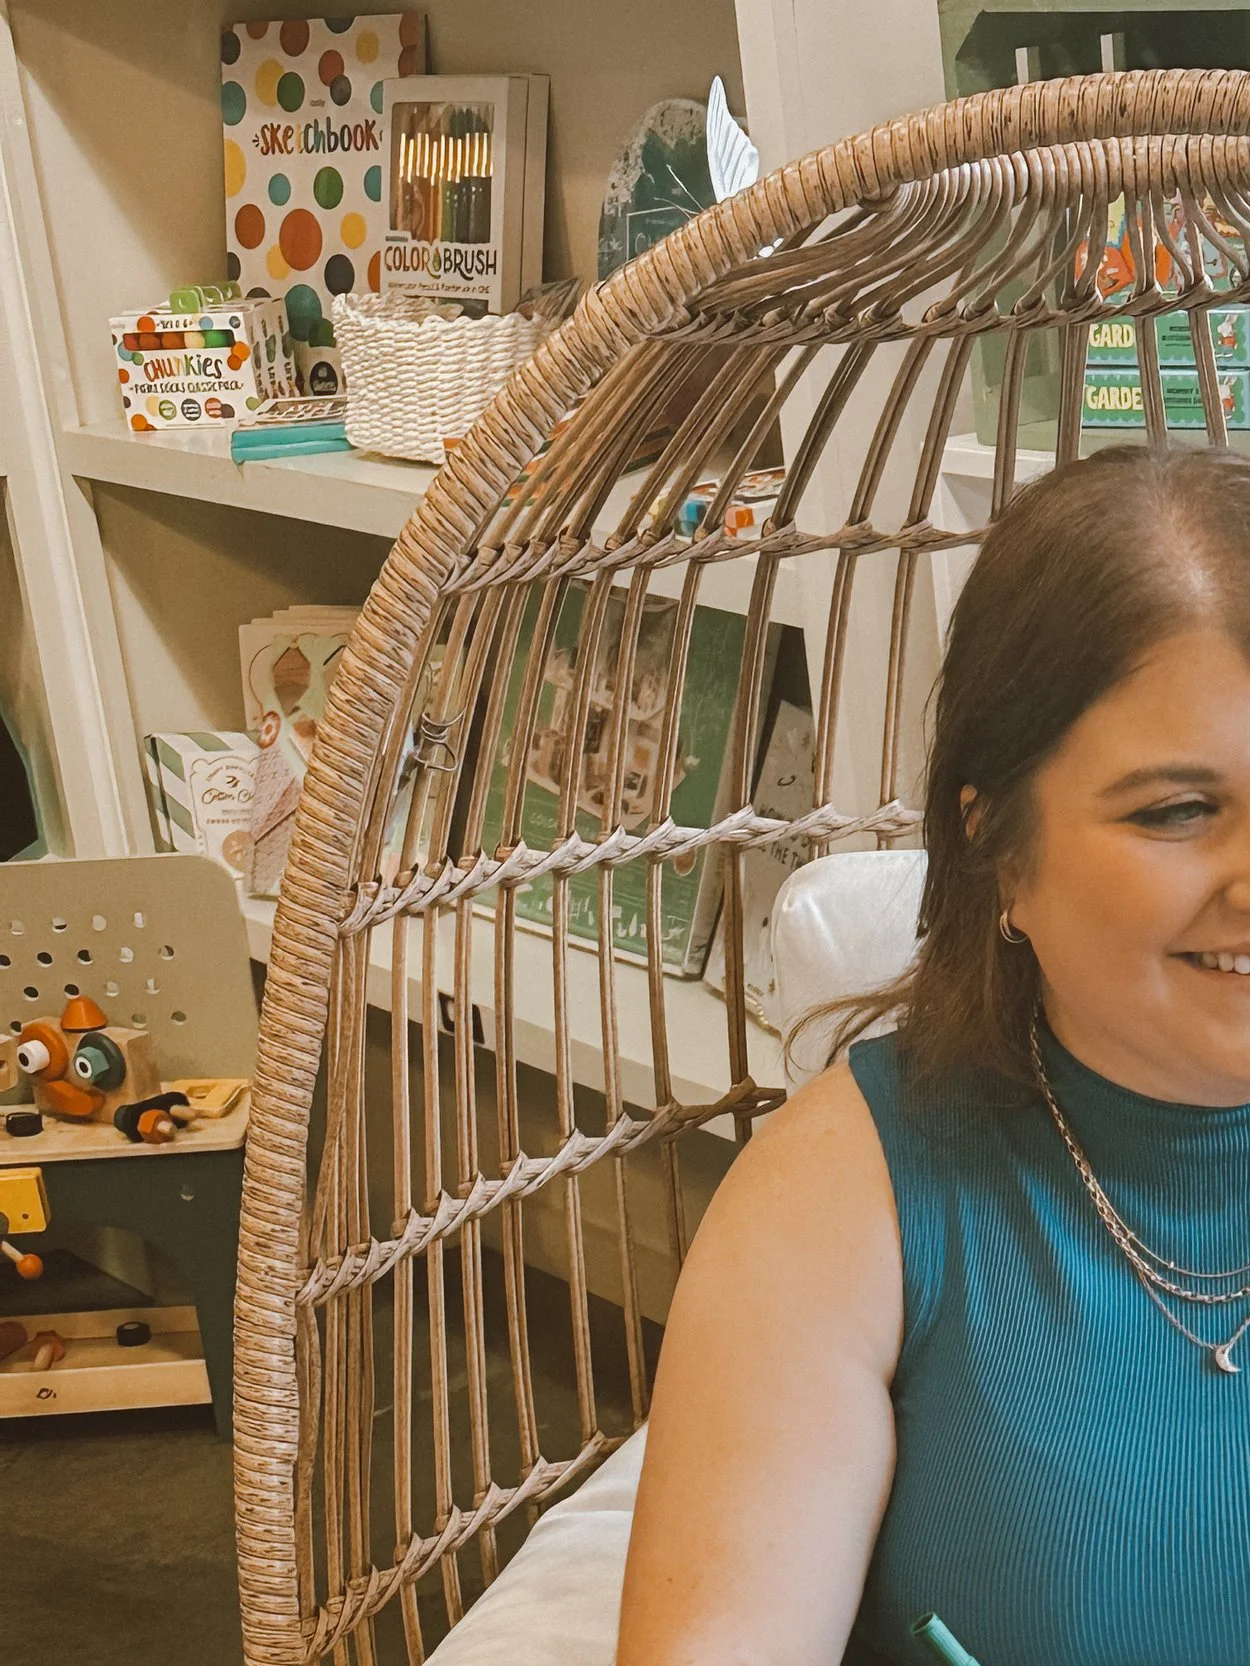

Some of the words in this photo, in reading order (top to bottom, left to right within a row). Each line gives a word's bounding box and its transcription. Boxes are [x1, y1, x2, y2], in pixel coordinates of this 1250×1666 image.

[384, 245, 441, 279] COLOR
[443, 247, 497, 280] BRUSH
[1089, 323, 1136, 348] GARD
[1086, 386, 1145, 410] GARDE
